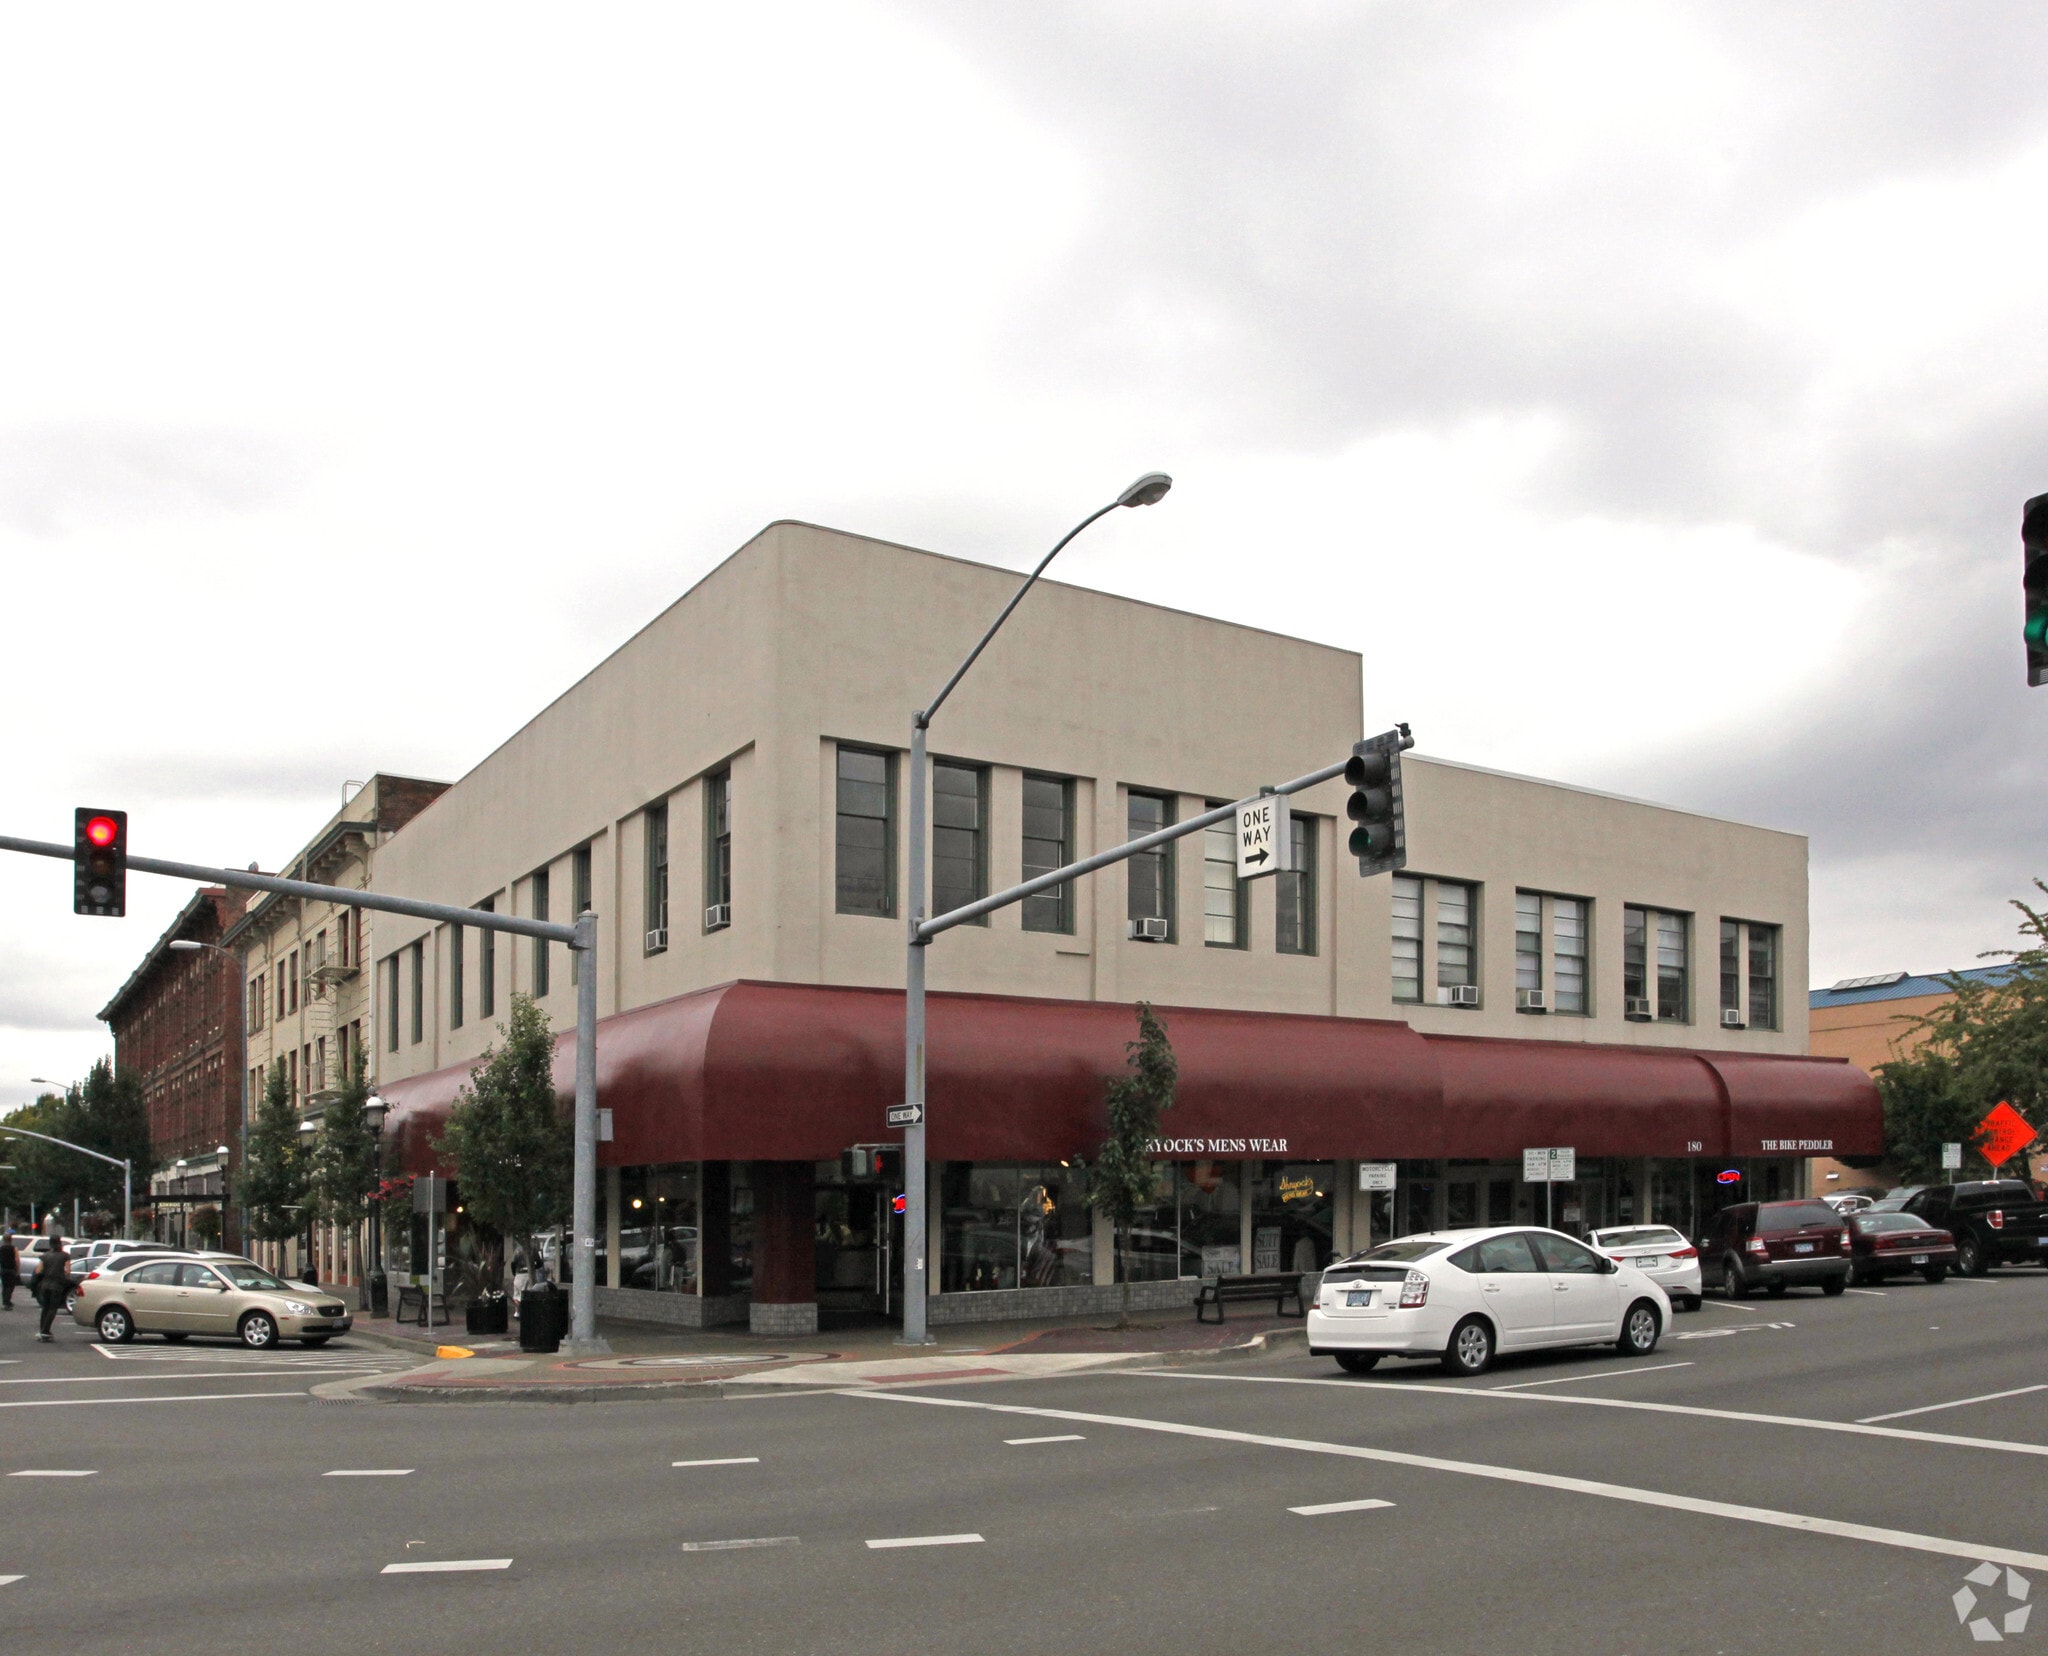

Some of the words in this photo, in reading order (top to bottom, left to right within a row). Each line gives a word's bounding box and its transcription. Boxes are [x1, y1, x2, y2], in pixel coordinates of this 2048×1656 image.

[1243, 806, 1270, 828] ONE
[1243, 825, 1271, 847] WAY
[891, 1112, 901, 1120] ONE
[903, 1111, 913, 1119] WAY
[1207, 1138, 1246, 1152] MENS
[1249, 1138, 1288, 1152] WEAR
[1687, 1141, 1702, 1152] 180
[1761, 1140, 1778, 1150] THE
[1779, 1140, 1797, 1150] BIKE
[1798, 1140, 1833, 1150] PEDDLER
[1551, 1150, 1556, 1158] 2
[1717, 1173, 1740, 1181] OPEN
[1257, 1232, 1280, 1248] SUIT
[1206, 1261, 1234, 1275] SALE
[1256, 1253, 1279, 1269] SALE
